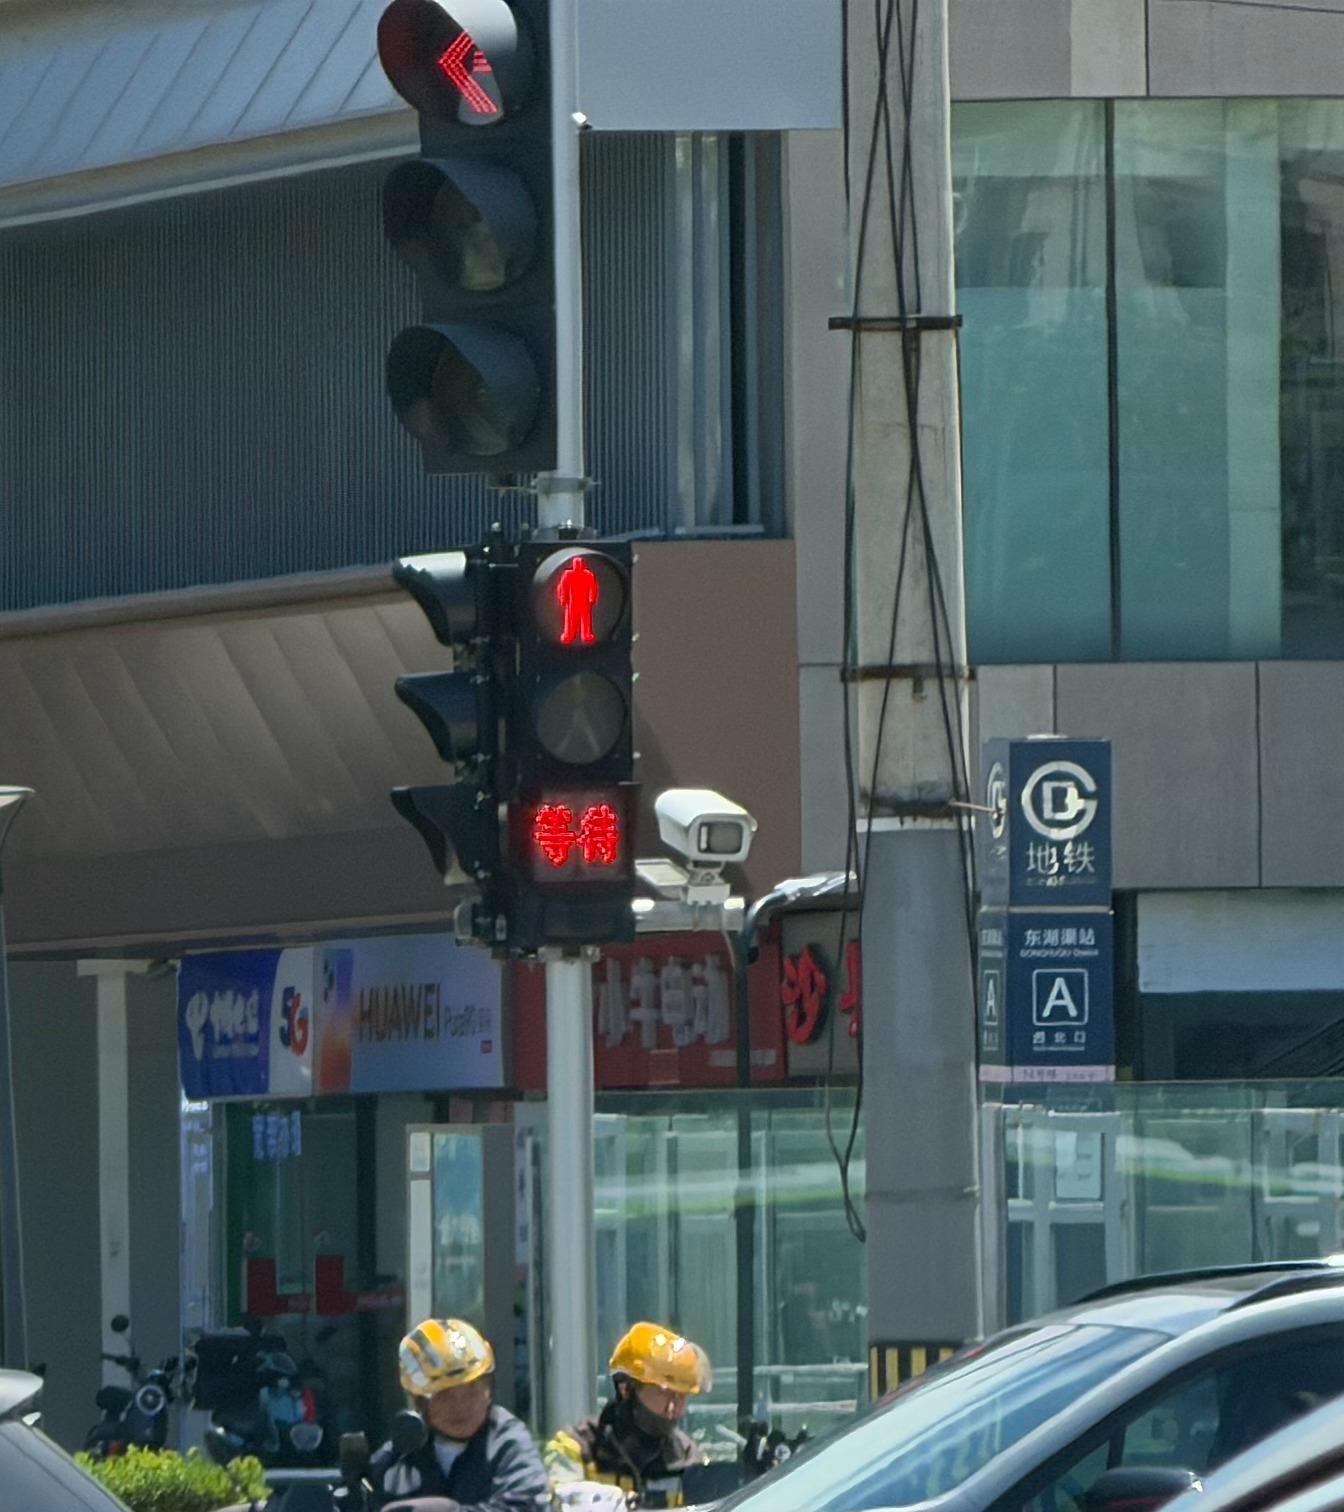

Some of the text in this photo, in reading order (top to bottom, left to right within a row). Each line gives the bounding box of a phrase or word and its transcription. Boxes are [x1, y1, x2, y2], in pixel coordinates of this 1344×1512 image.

[1026, 841, 1095, 874] 地铁
[1025, 928, 1095, 946] 东湖渠站
[358, 983, 441, 1042] HUAWEI
[1041, 977, 1078, 1018] A
[279, 986, 310, 1057] 5G
